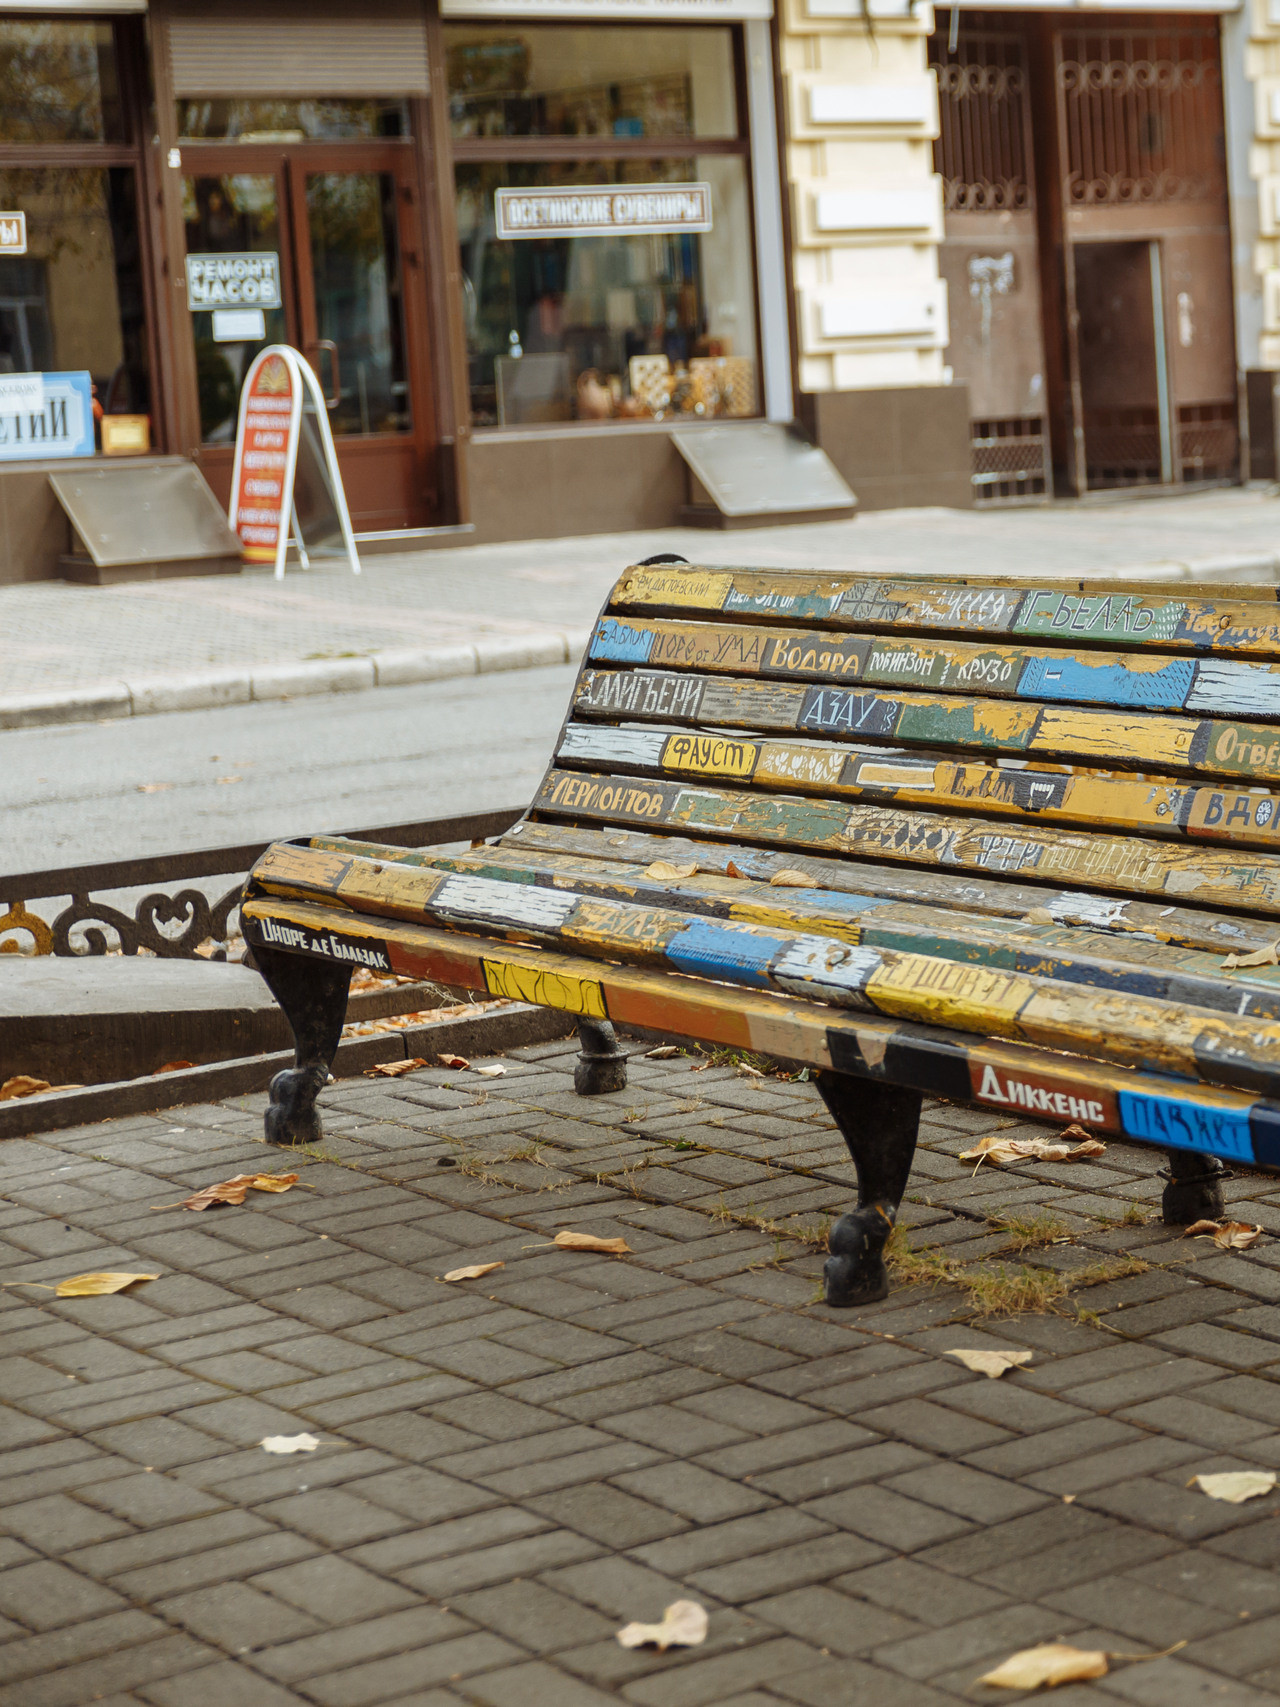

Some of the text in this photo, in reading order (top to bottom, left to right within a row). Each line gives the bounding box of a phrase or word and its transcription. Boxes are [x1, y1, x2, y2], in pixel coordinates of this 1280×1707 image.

[191, 259, 275, 280] РЕМОНТ
[192, 279, 276, 302] ЧАСОВ
[711, 633, 760, 663] УМА
[869, 651, 1013, 683] РОБИНЗОН КРУЗО
[551, 776, 664, 817] ЛЕРМОНТОВ
[978, 1064, 1105, 1123] ДИККЕНС
